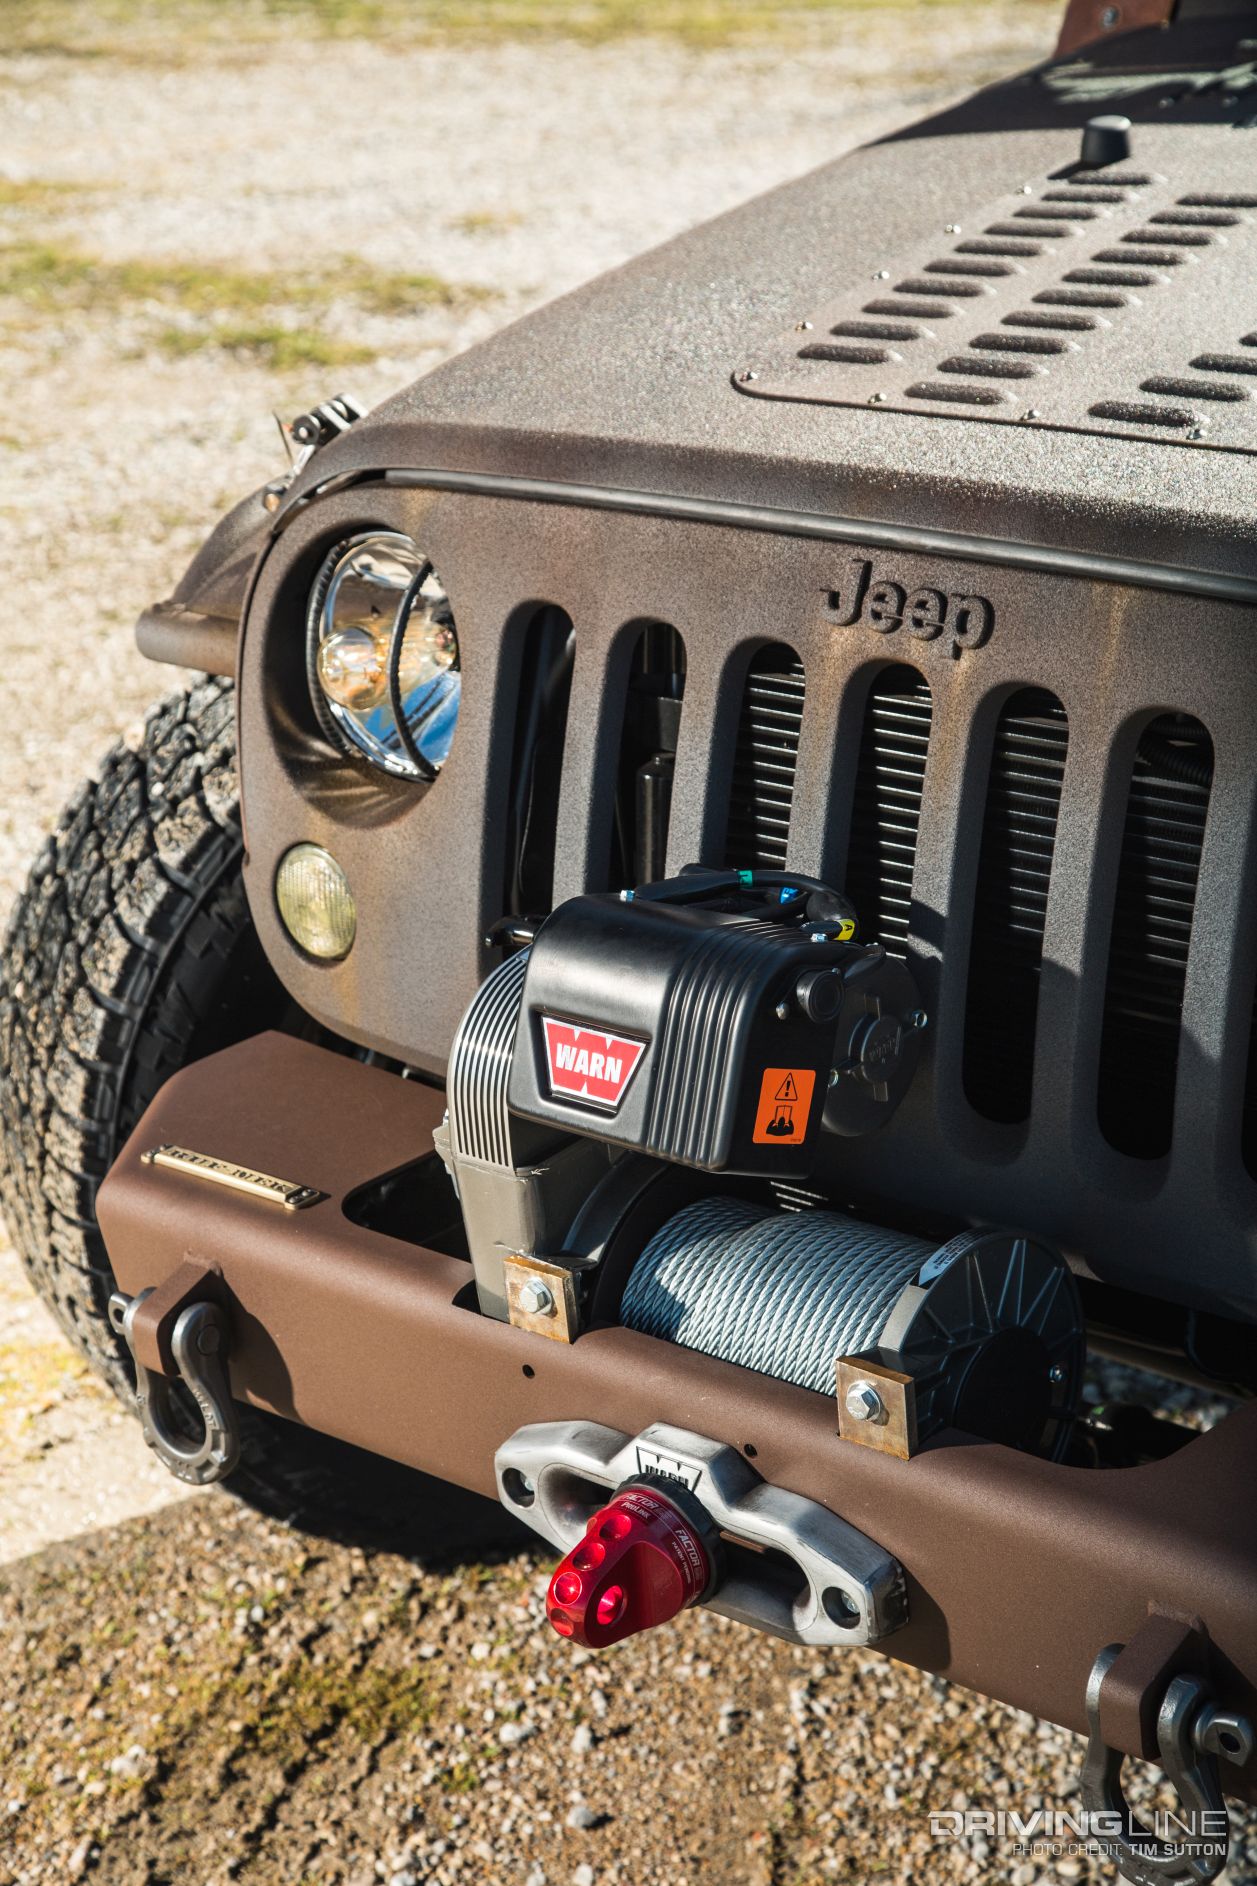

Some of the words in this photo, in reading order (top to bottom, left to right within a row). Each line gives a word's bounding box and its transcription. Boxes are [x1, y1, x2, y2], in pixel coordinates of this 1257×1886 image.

[819, 558, 996, 661] Jeep
[555, 1042, 623, 1084] WARN
[675, 1529, 701, 1567] FACTOR
